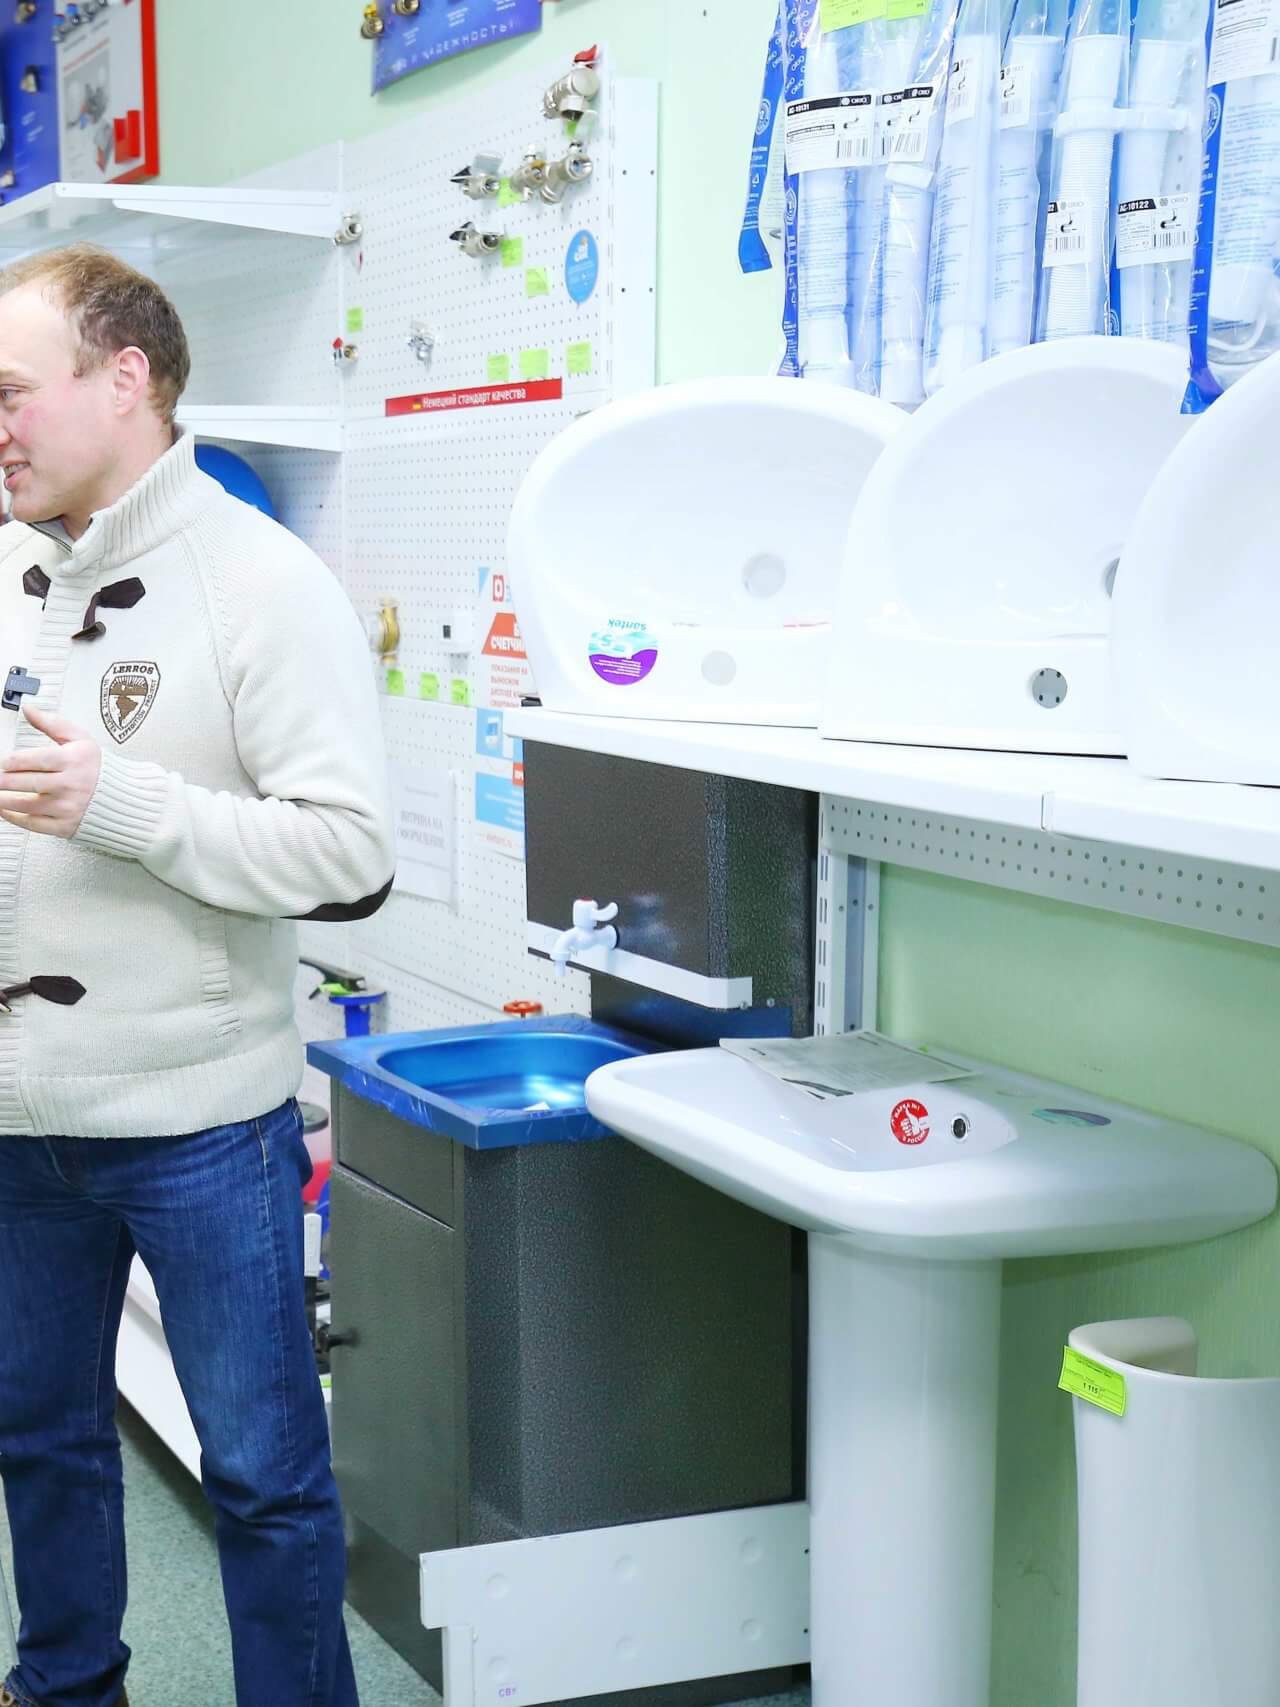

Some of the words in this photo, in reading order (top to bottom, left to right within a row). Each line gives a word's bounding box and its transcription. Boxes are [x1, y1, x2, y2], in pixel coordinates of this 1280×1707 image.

[423, 393, 457, 409] Немецкий
[457, 391, 491, 406] стандарт
[491, 387, 526, 402] качества
[113, 664, 154, 675] LERROS
